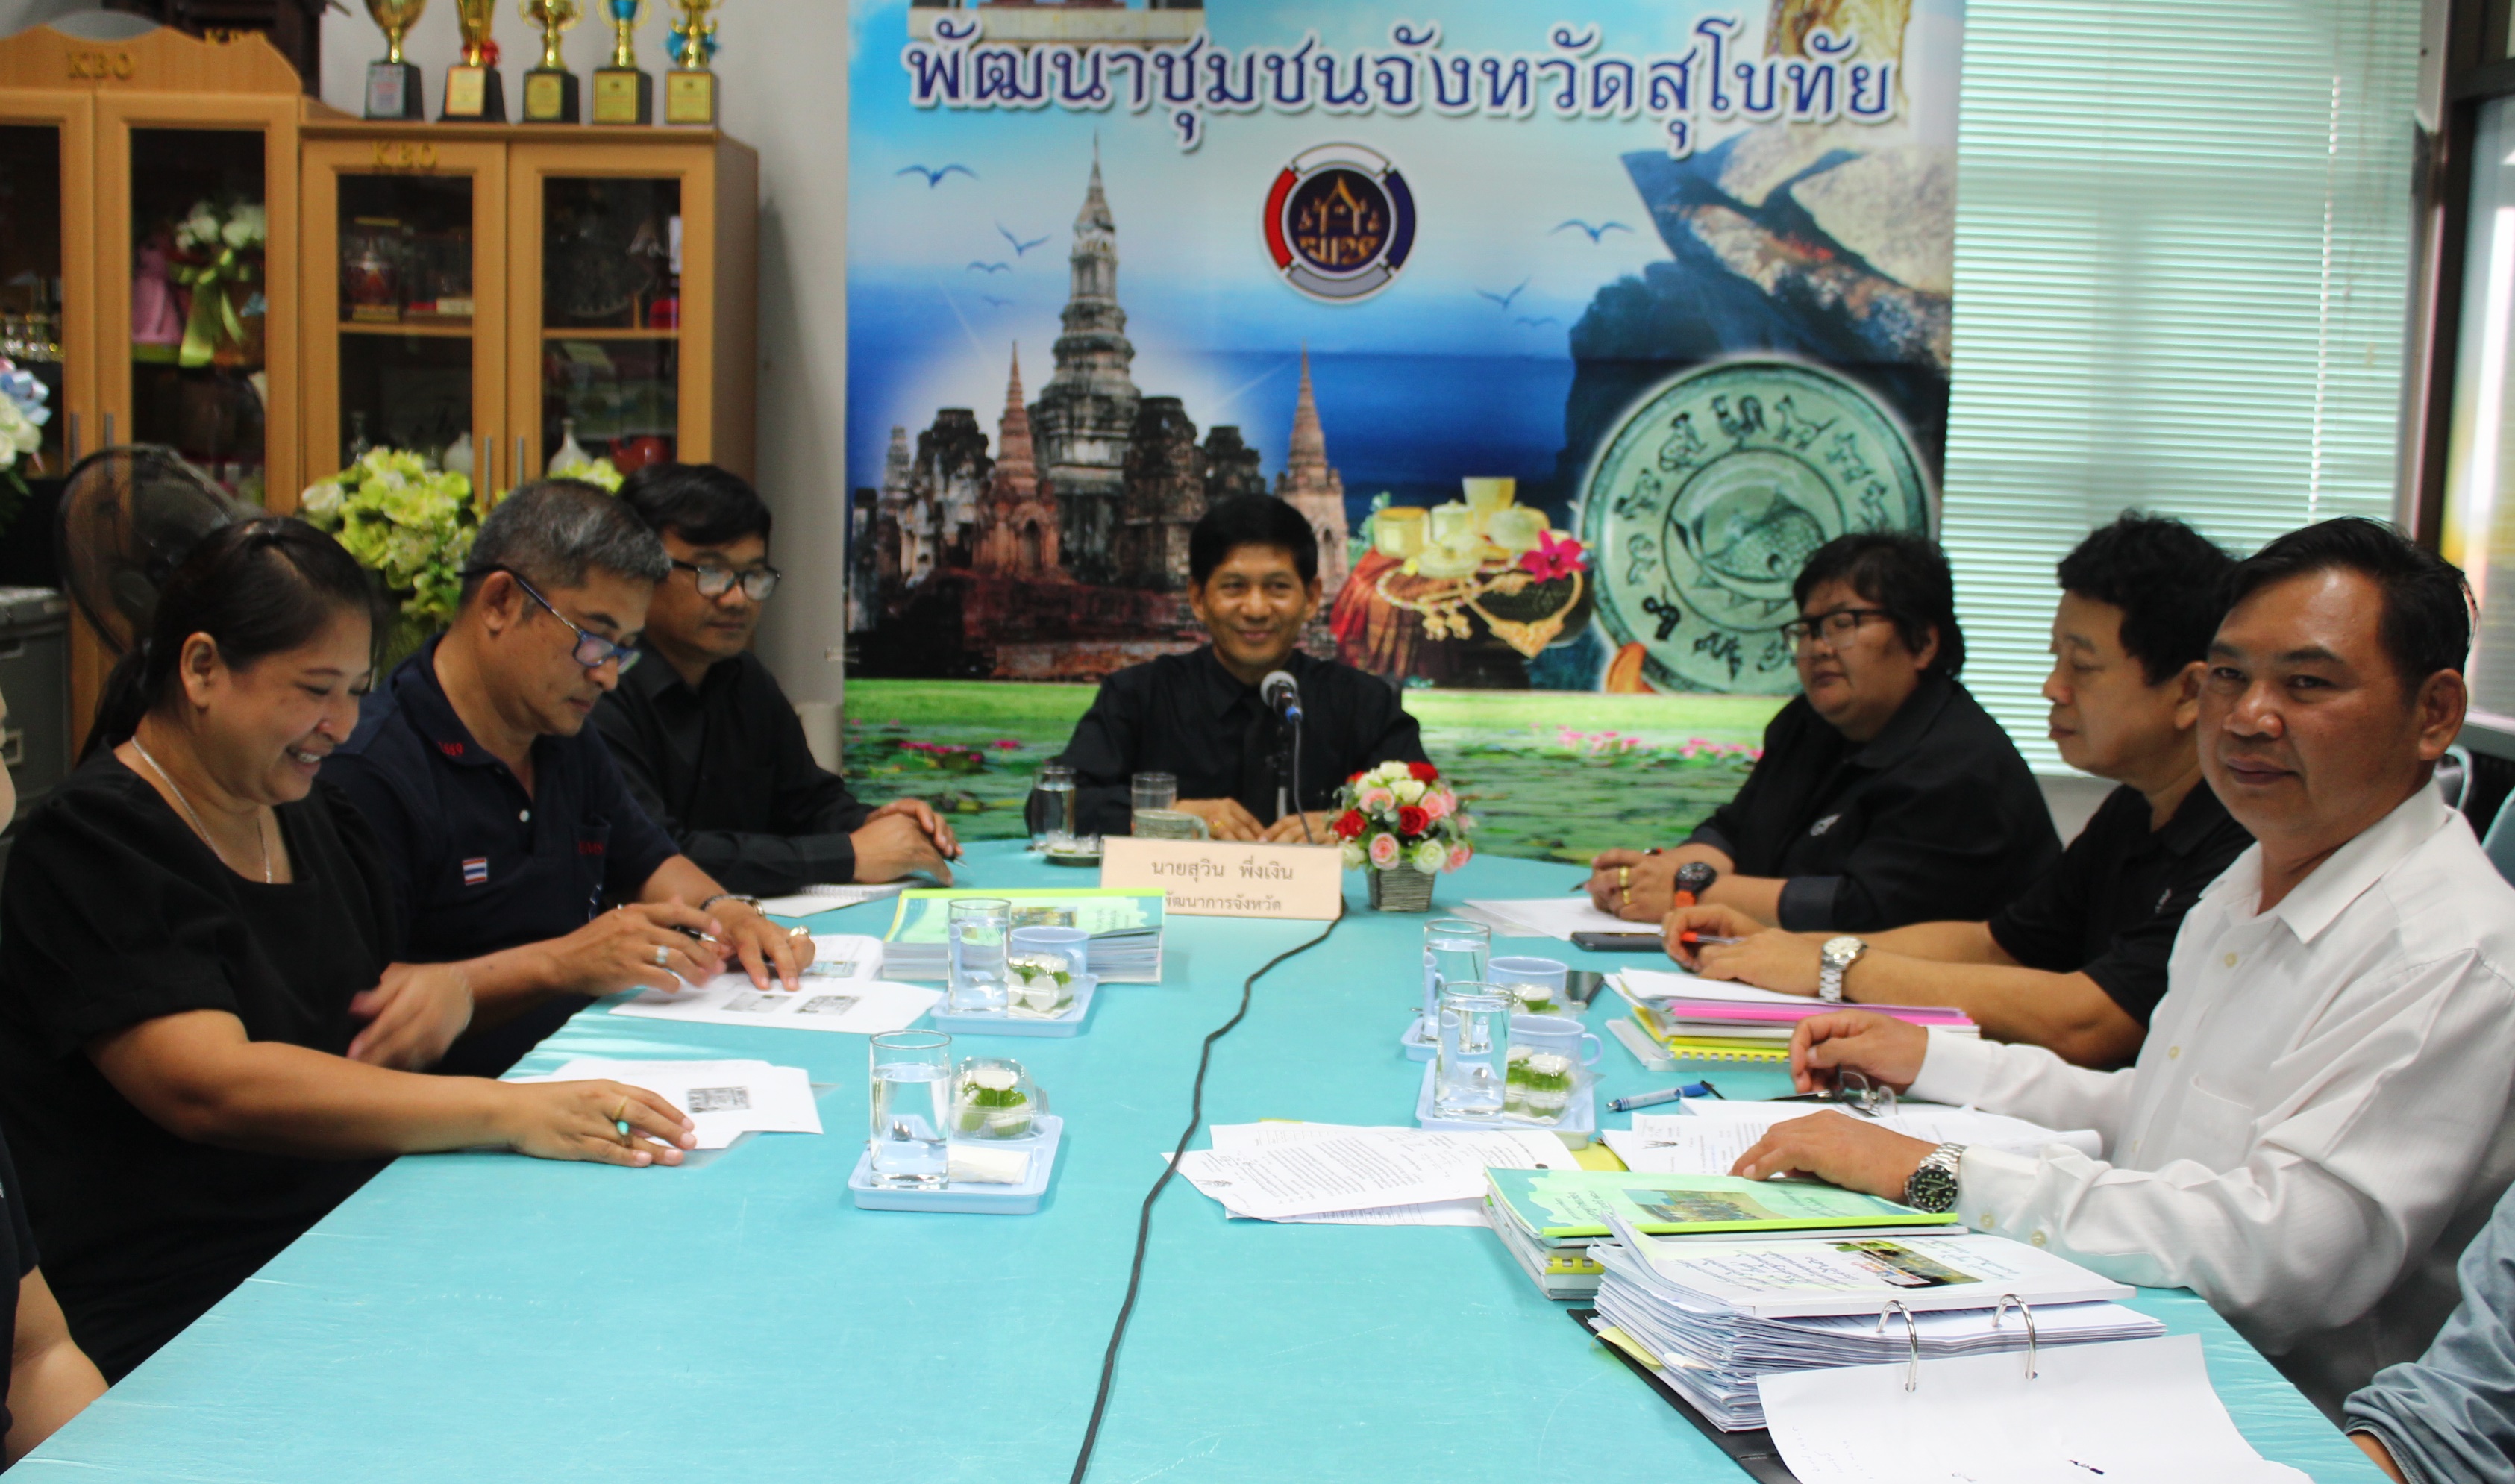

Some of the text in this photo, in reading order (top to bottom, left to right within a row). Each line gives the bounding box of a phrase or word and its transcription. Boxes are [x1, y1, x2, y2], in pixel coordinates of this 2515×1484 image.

[66, 50, 136, 80] KBO
[905, 15, 1894, 151] พัฒนาชุมชนจังหวัดสุโขทัย
[371, 140, 438, 169] KBO
[1151, 858, 1224, 883] นายสุวิน
